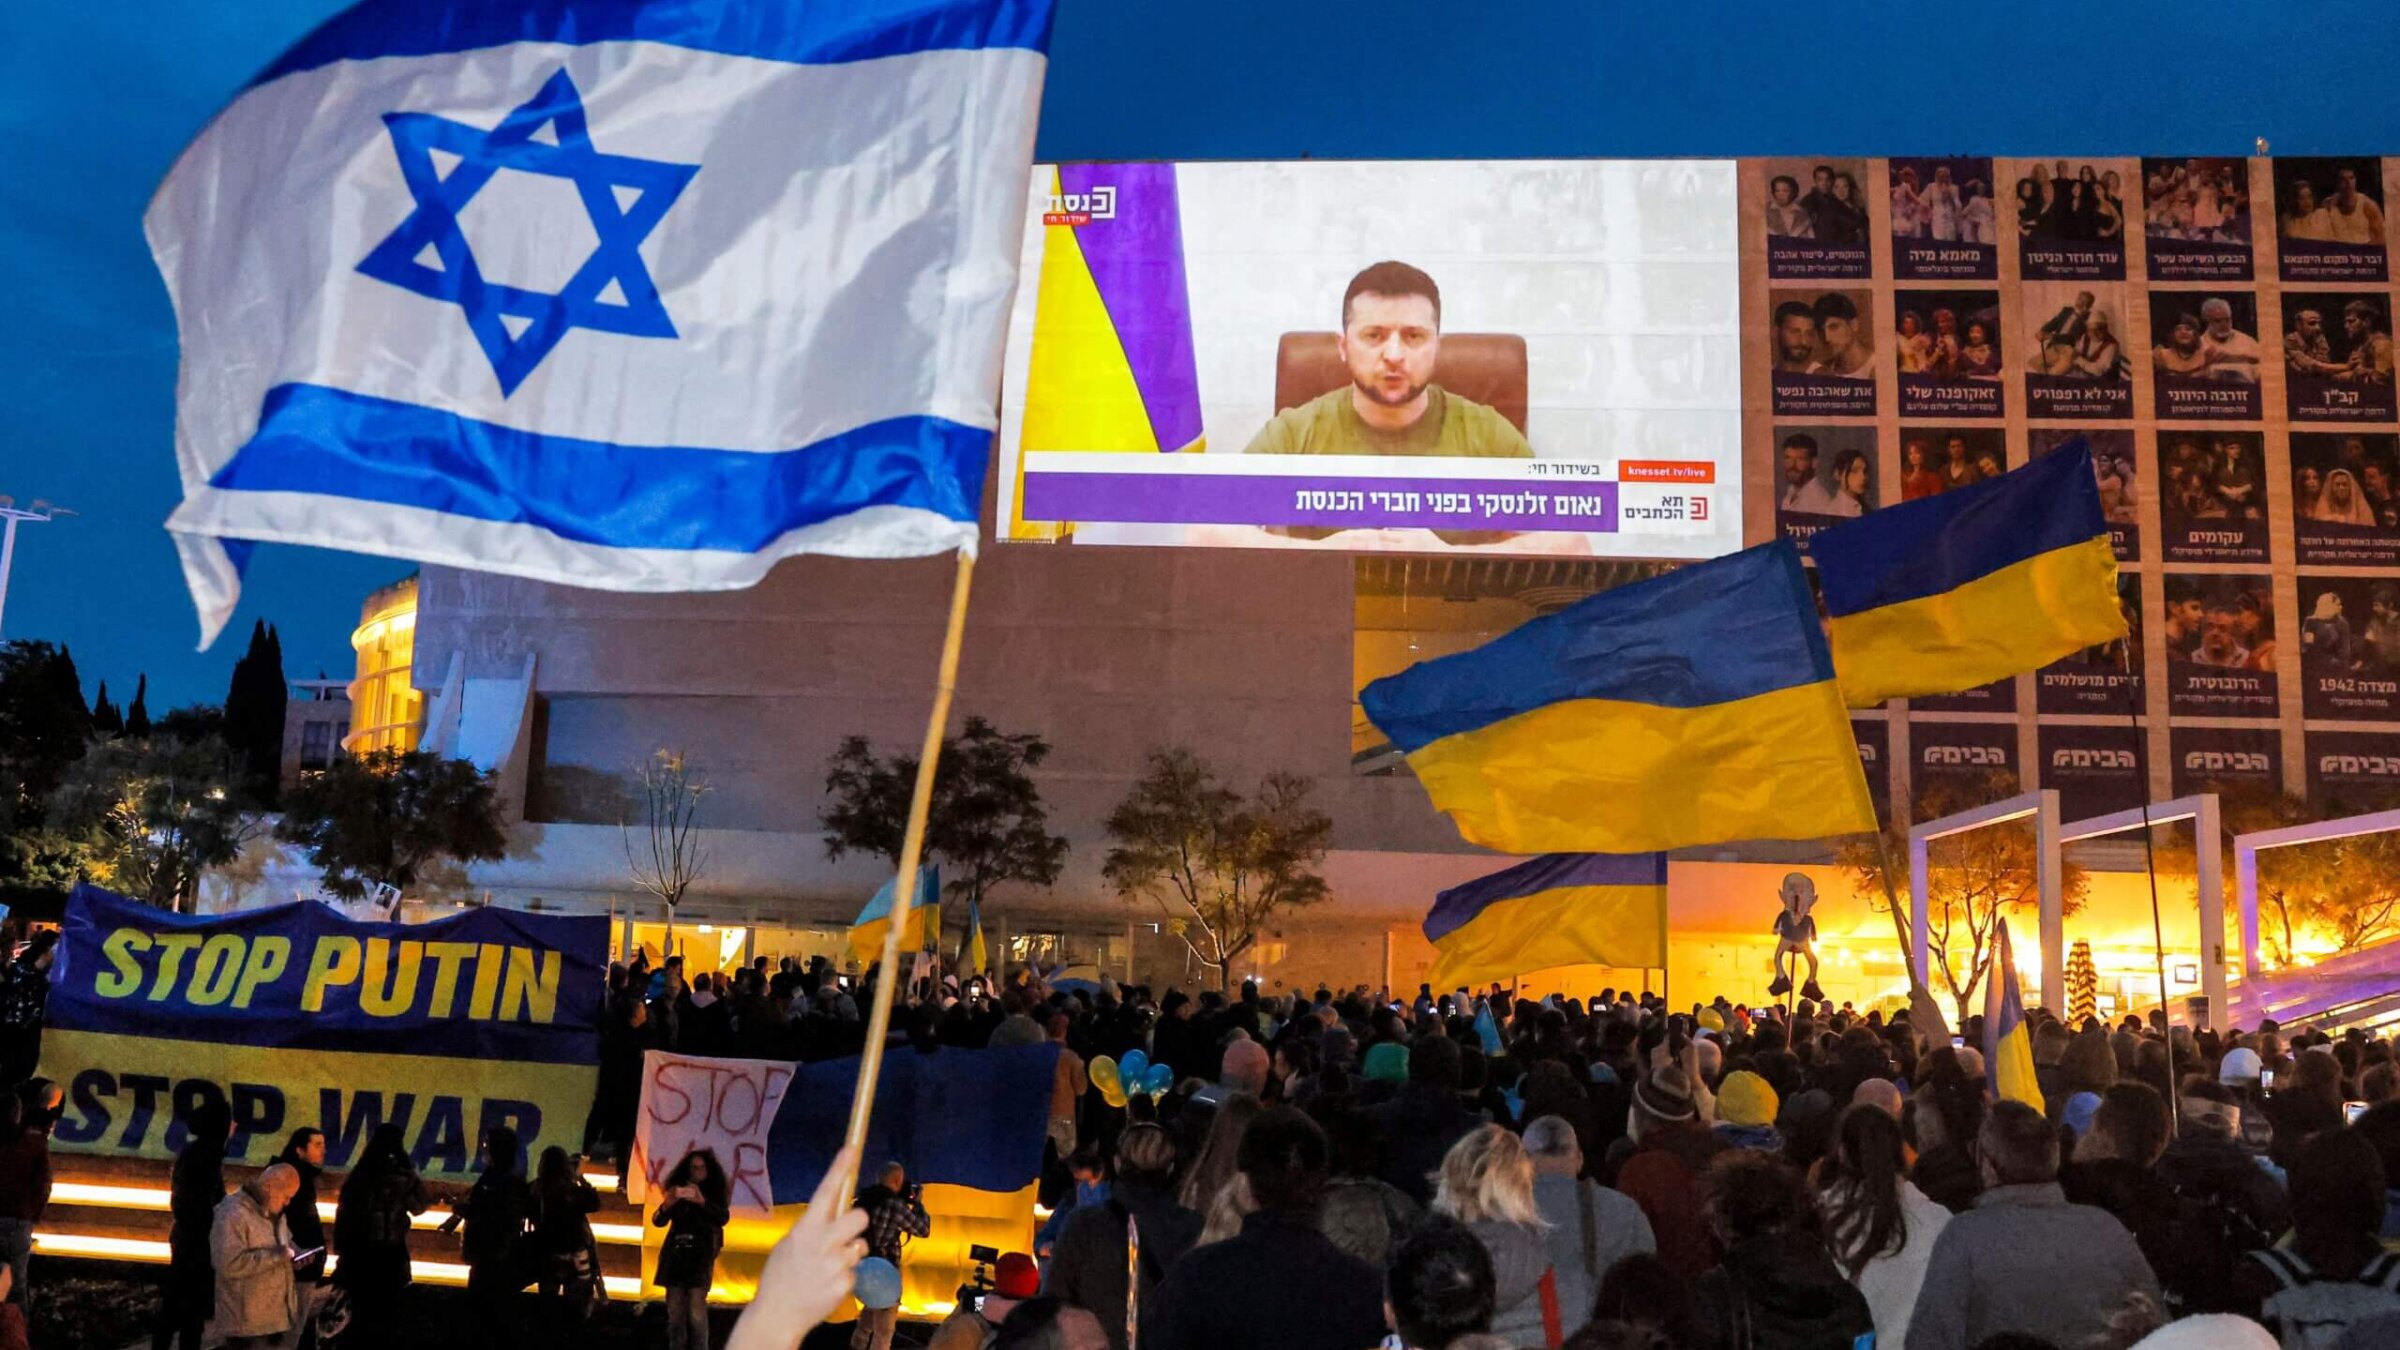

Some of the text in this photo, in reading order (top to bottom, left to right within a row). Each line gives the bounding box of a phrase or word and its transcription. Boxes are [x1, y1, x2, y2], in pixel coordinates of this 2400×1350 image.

[1046, 215, 1057, 223] חי
[1799, 250, 1824, 260] סיפור
[1909, 250, 1981, 262] מאמא מיה
[2066, 253, 2094, 263] חוזר
[2096, 253, 2118, 263] עוד
[2154, 254, 2246, 264] הכבש השישה עשר
[1776, 386, 1872, 397] את שאהבה נפשי
[1906, 385, 1996, 402] זאקופנה שלי
[2085, 386, 2102, 400] לא
[2104, 389, 2127, 400] אני
[2168, 390, 2249, 401] זורבה היווני
[1528, 463, 1600, 475] בשידור חי:
[1296, 490, 1602, 518] נאום זלנסקי בפני חברי הכנסת
[1661, 495, 1684, 507] תא
[1625, 506, 1684, 520] הכתבים
[2189, 531, 2243, 546] עקומים
[2044, 672, 2105, 687] מושלמים
[2188, 677, 2259, 690] הרובוטית
[2320, 678, 2397, 693] מצדה 1942
[95, 927, 561, 1024] STOP PUTIN
[647, 1062, 793, 1137] STOP
